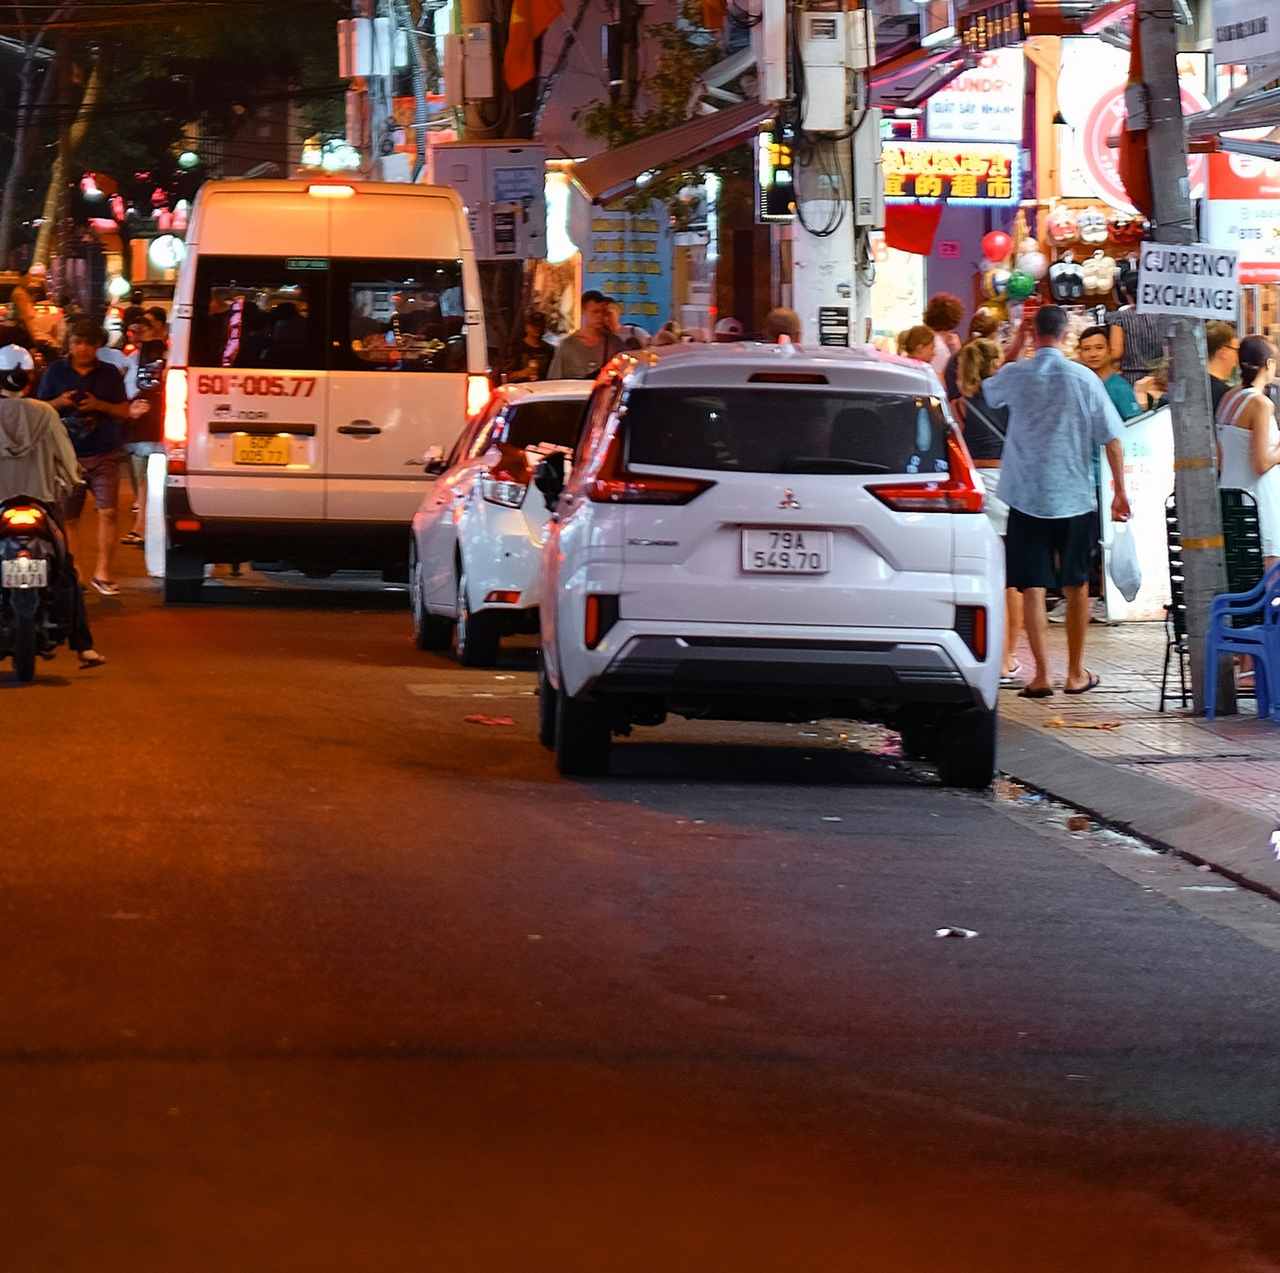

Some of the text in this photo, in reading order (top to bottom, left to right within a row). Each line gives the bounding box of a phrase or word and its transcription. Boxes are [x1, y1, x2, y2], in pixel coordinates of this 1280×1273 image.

[1143, 250, 1237, 278] CURRENCY
[1142, 283, 1235, 311] EXCHANGE
[769, 532, 805, 551] 79A
[754, 552, 820, 570] 549.70
